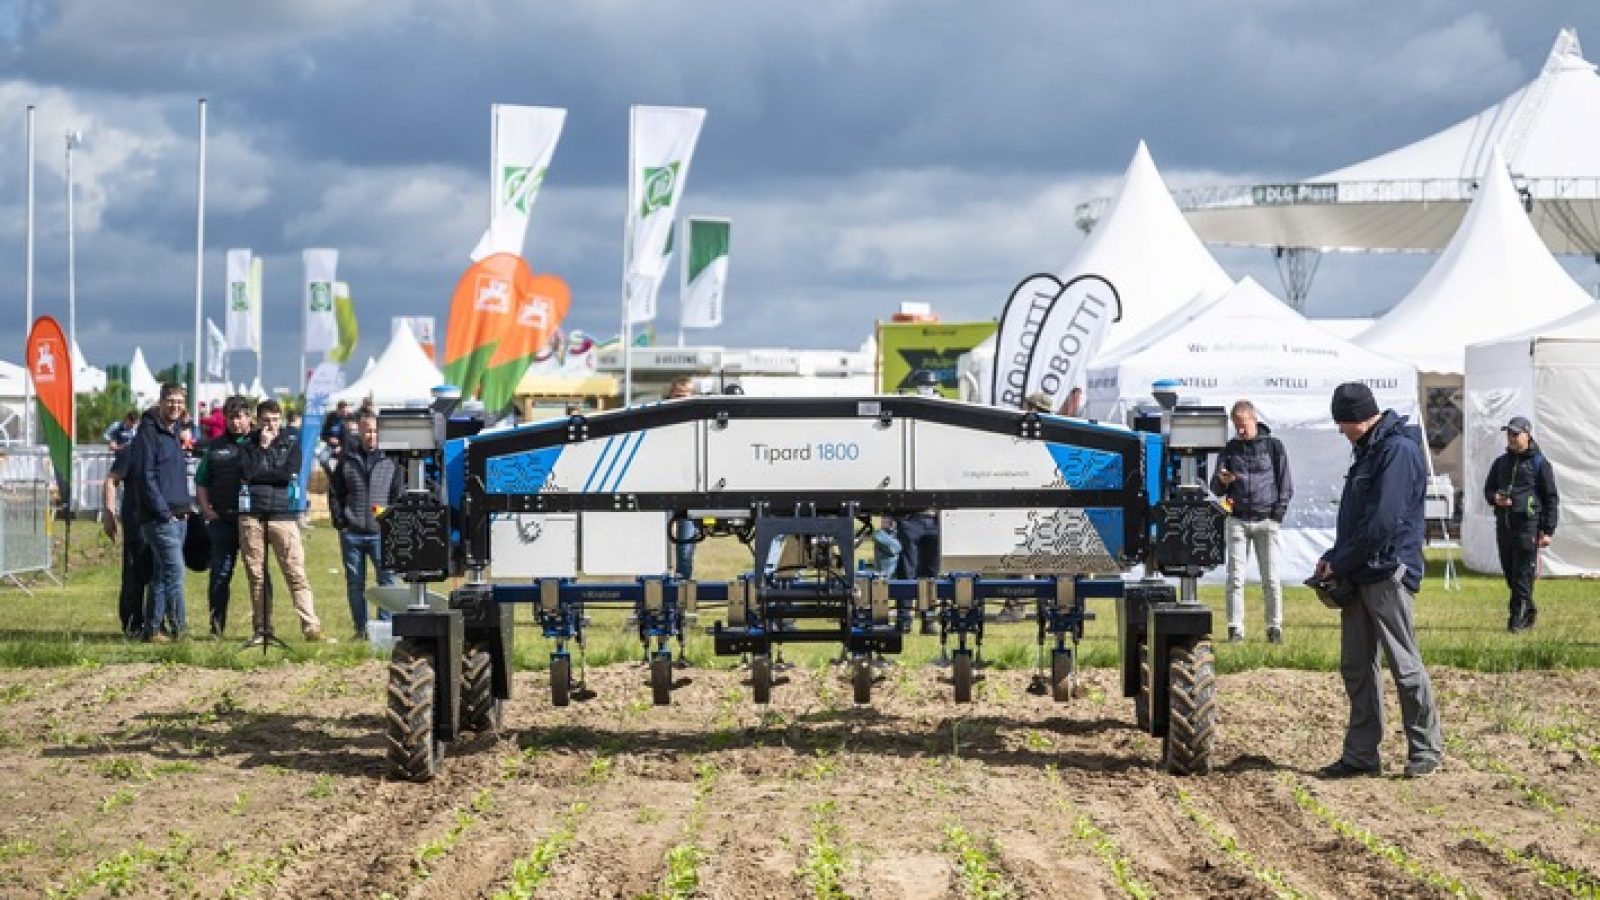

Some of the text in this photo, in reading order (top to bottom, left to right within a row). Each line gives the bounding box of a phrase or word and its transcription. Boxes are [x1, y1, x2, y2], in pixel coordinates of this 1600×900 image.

[1040, 293, 1106, 397] OBOTTI
[750, 442, 860, 466] Tipard 1800
